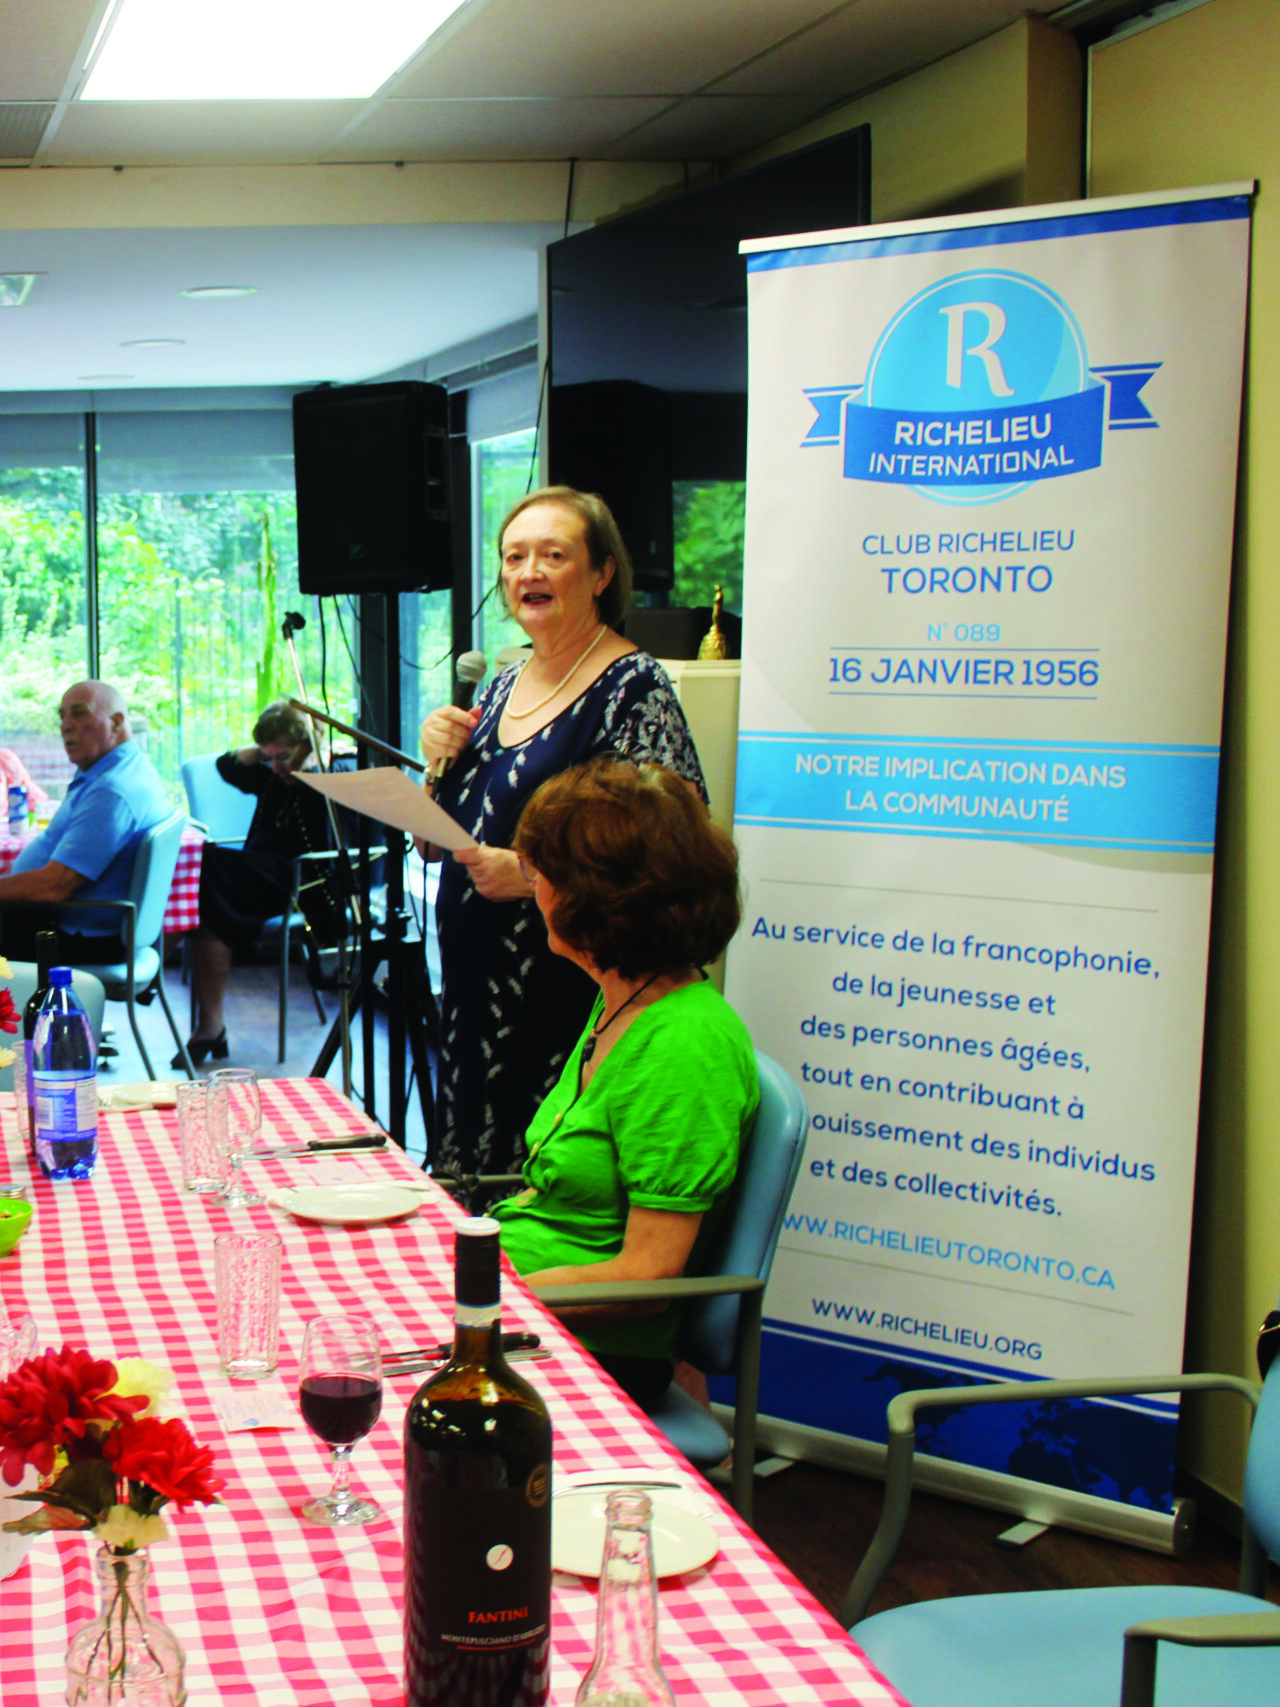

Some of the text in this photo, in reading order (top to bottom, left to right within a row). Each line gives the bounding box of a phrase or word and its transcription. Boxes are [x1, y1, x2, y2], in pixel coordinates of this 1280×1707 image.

[939, 301, 1016, 398] R
[894, 412, 1052, 446] RICHELIEU
[869, 445, 1074, 477] INTERNATIONAL
[862, 529, 1075, 555] CLUB RICHELIEU
[880, 564, 1054, 594] TORONTO
[954, 623, 1001, 643] 089
[829, 657, 1100, 687] 16 JANVIER 1956
[795, 753, 1127, 789] NOTRE IMPLICATION DANS
[845, 790, 1070, 823] LA COMMUNAUTÉ
[751, 916, 1160, 979] Au service de la francophonie,
[832, 971, 1057, 1016] de la jeunesse et
[800, 1014, 1091, 1073] des personnes âgées,
[801, 1062, 1085, 1120] tout en contribuant à
[811, 1112, 1156, 1182] ouissement des individus
[810, 1159, 1062, 1217] et des collectivités.
[782, 1213, 1116, 1291] WW.RICHELIEUTORONTO.CA
[812, 1298, 1043, 1361] WWW.RICHELIEU.ORG
[468, 1606, 528, 1624] FANTINI
